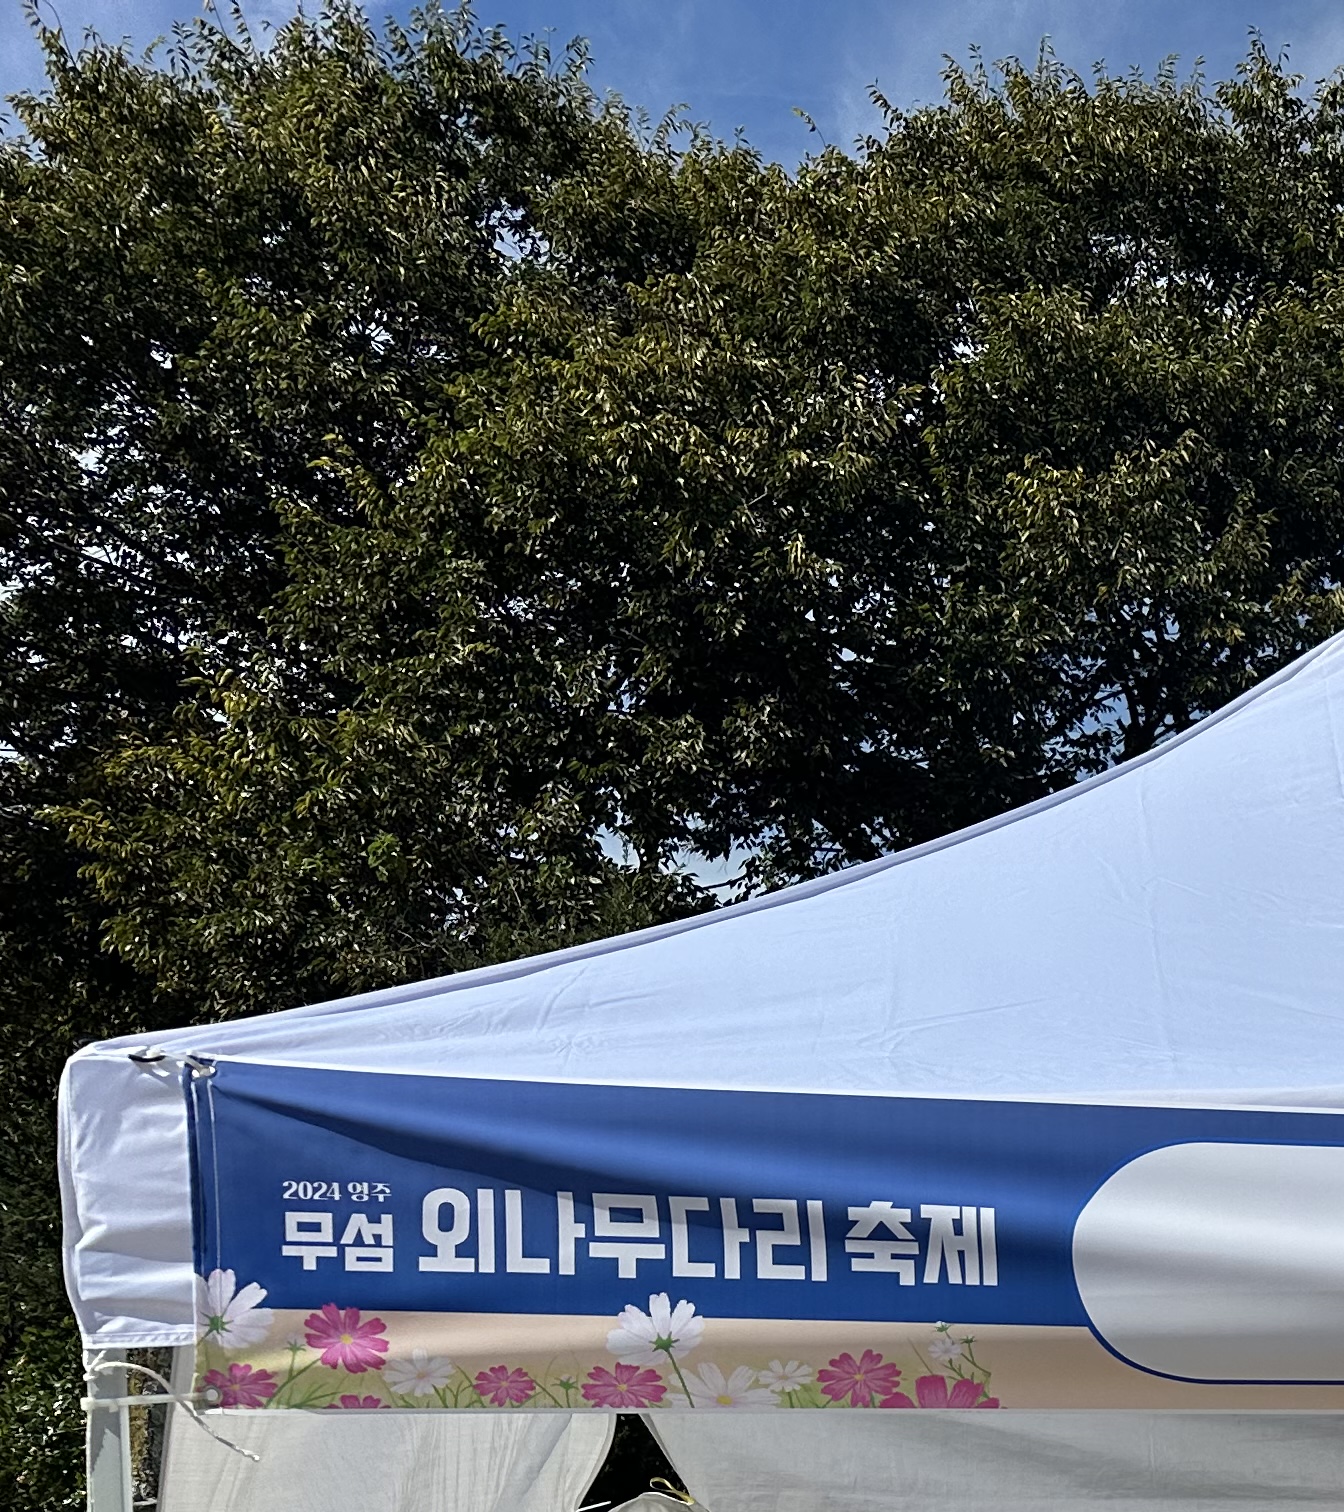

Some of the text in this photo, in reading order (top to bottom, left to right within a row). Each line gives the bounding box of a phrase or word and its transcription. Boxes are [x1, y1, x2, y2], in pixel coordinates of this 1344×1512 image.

[282, 1180, 392, 1203] 2024 영주
[282, 1187, 998, 1286] 무섬 외나무다리 축제
